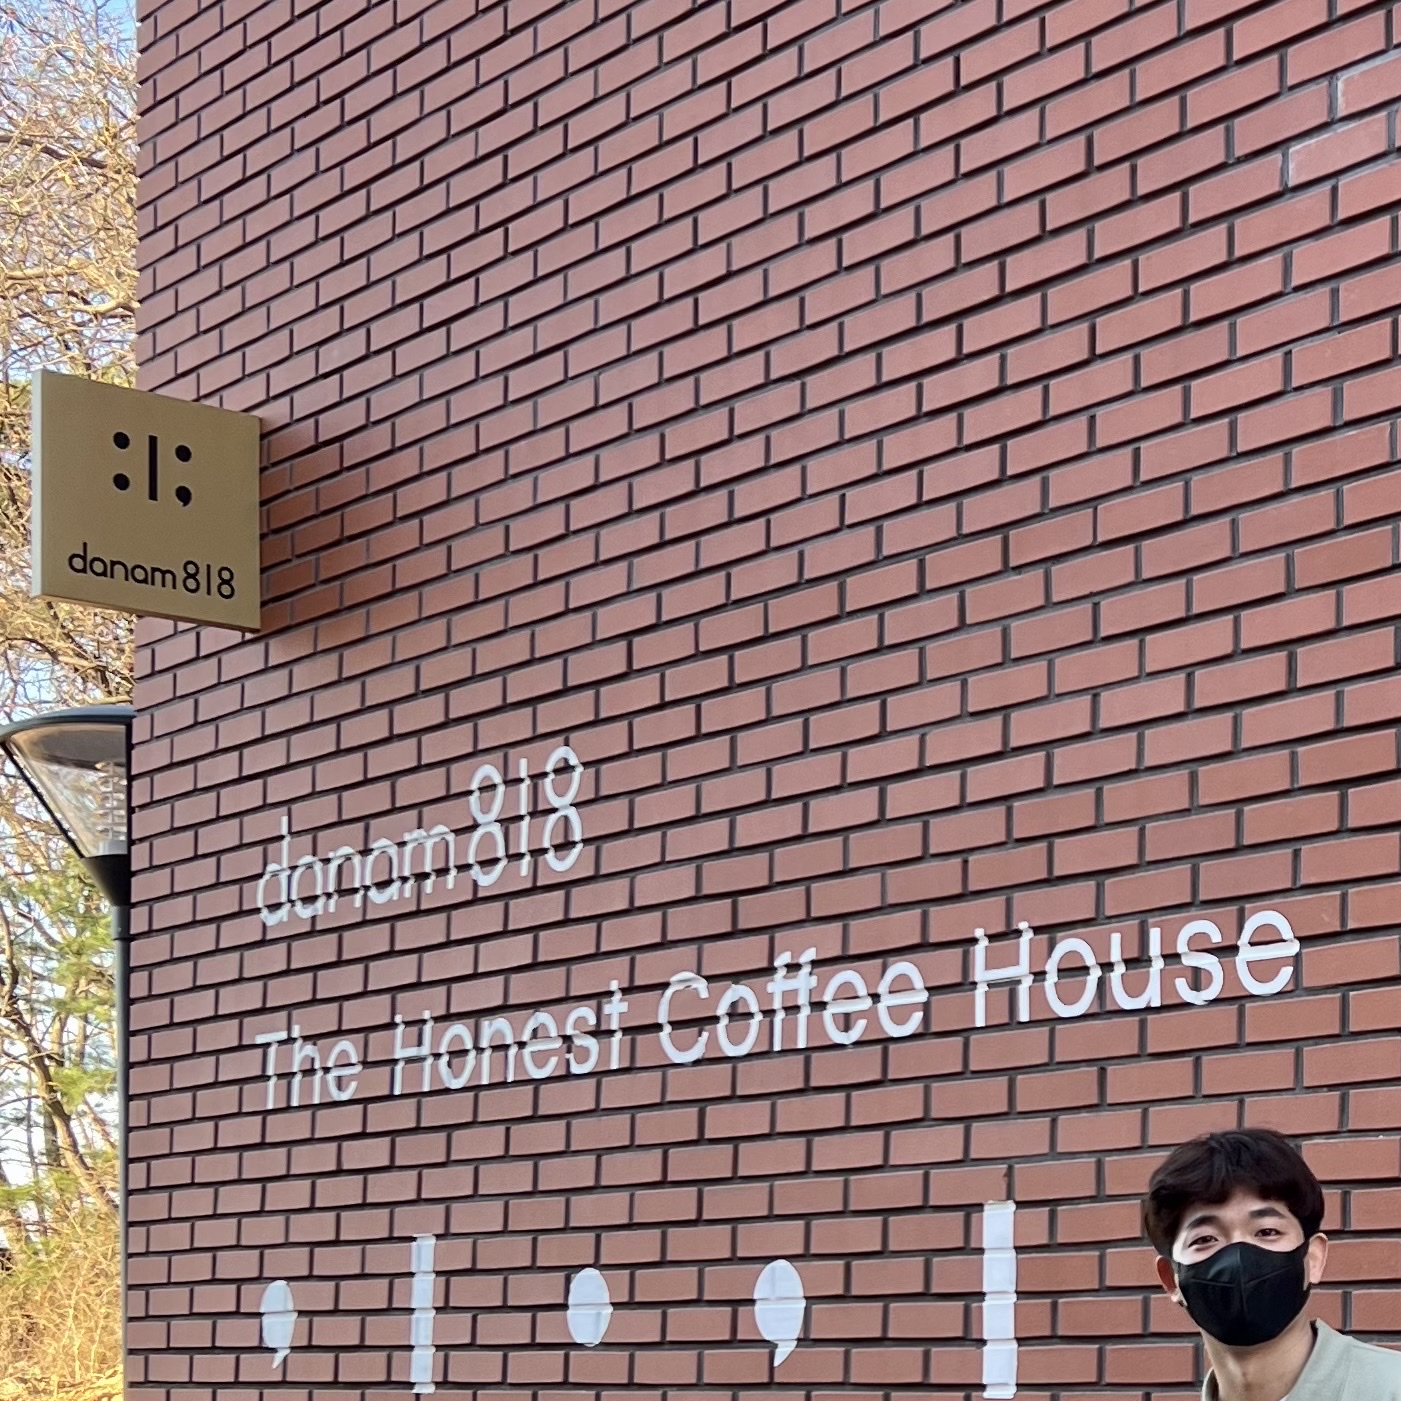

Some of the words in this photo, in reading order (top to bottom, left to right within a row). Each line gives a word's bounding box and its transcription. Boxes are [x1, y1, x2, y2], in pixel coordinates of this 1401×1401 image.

[68, 541, 235, 599] danam818
[257, 746, 584, 926] danam818
[255, 1025, 363, 1110] The
[393, 979, 629, 1095] Honest
[658, 947, 928, 1064] Coffee
[974, 909, 1300, 1027] House
